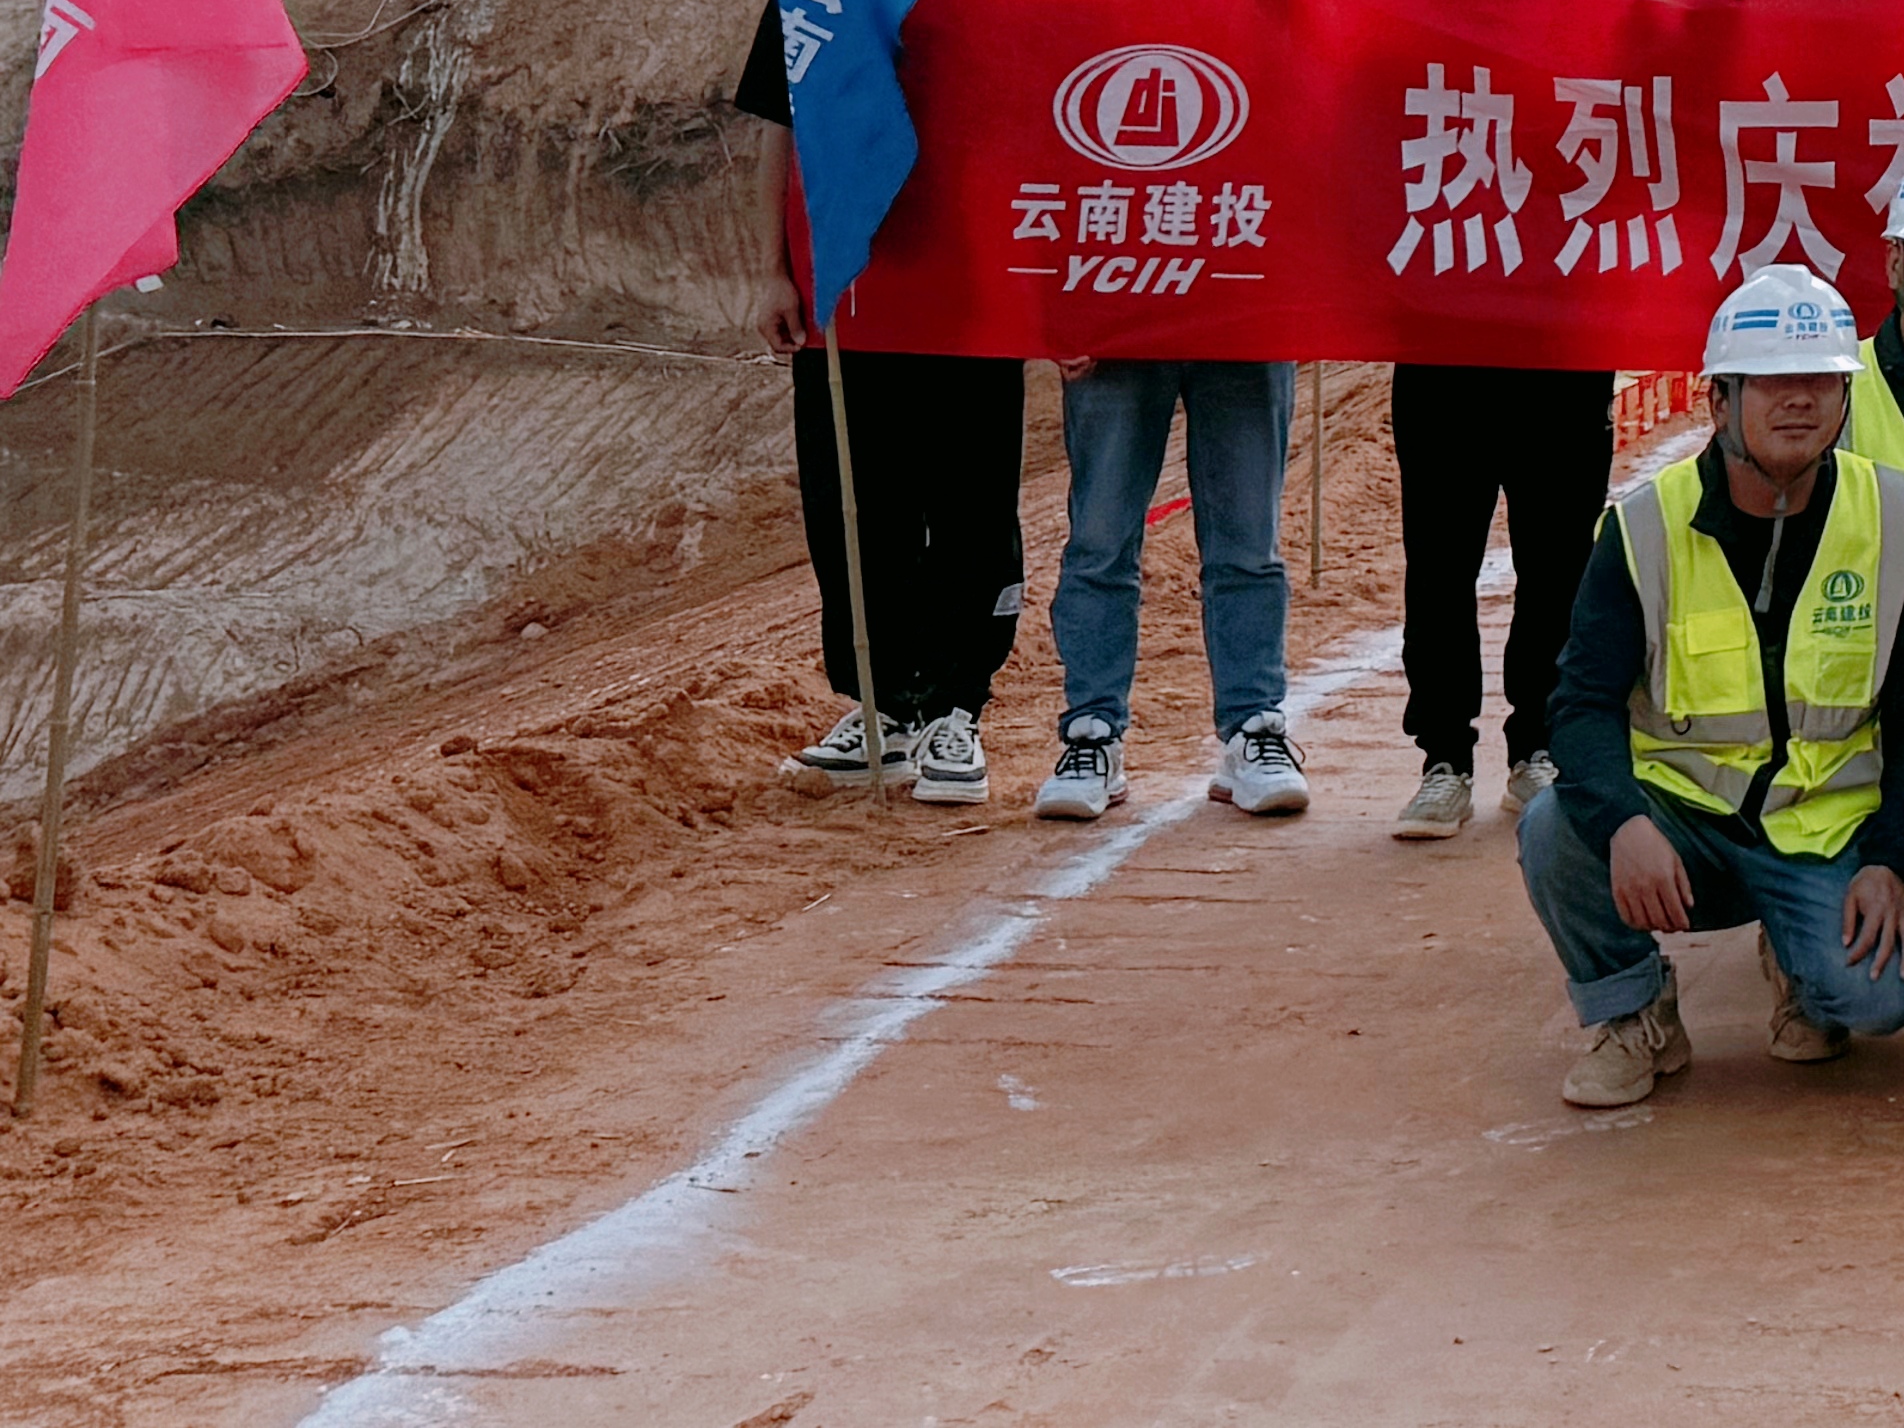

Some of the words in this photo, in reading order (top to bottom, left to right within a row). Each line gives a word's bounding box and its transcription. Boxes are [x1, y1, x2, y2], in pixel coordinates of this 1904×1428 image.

[1012, 180, 1270, 246] 云南建投
[1064, 256, 1204, 293] YCIH
